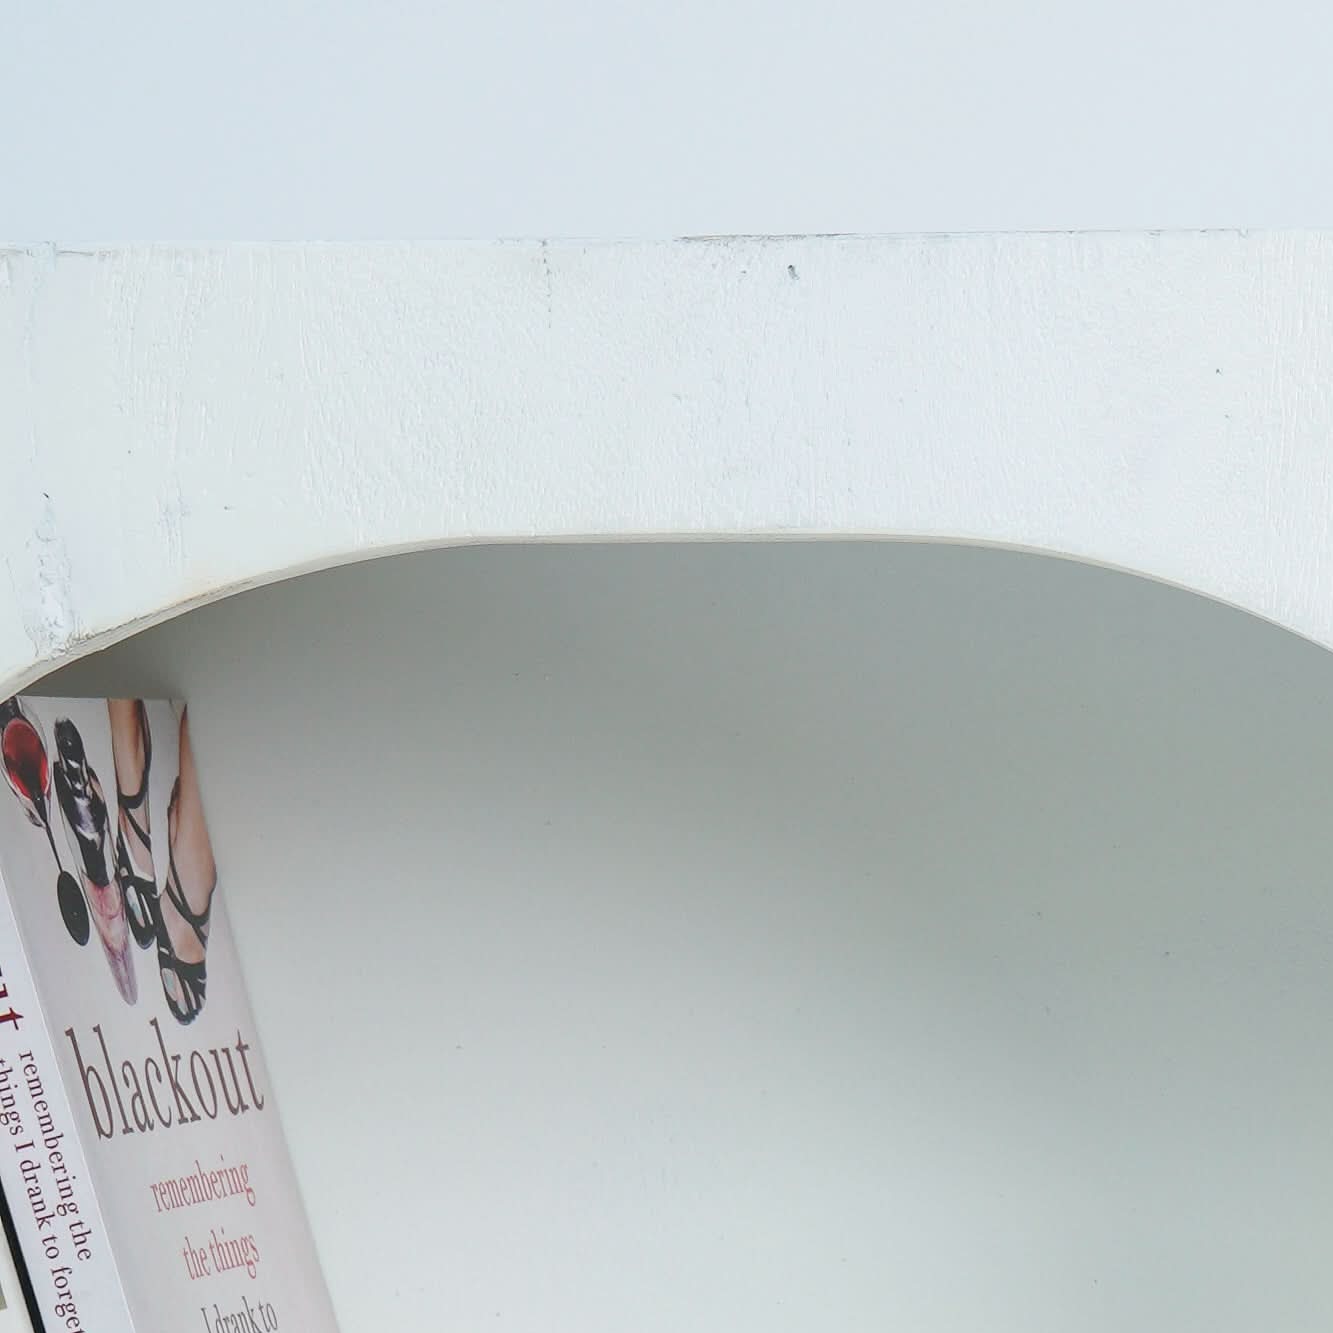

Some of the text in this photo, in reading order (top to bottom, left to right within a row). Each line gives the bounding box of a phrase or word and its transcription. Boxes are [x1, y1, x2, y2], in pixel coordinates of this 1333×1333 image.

[65, 1017, 265, 1141] blackout
[15, 1140, 35, 1153] I
[18, 1049, 92, 1261] remembering the
[20, 1160, 55, 1231] drank
[149, 1153, 257, 1213] remembering
[42, 1235, 60, 1260] to
[182, 1226, 260, 1280] the things
[258, 1302, 279, 1333] to
